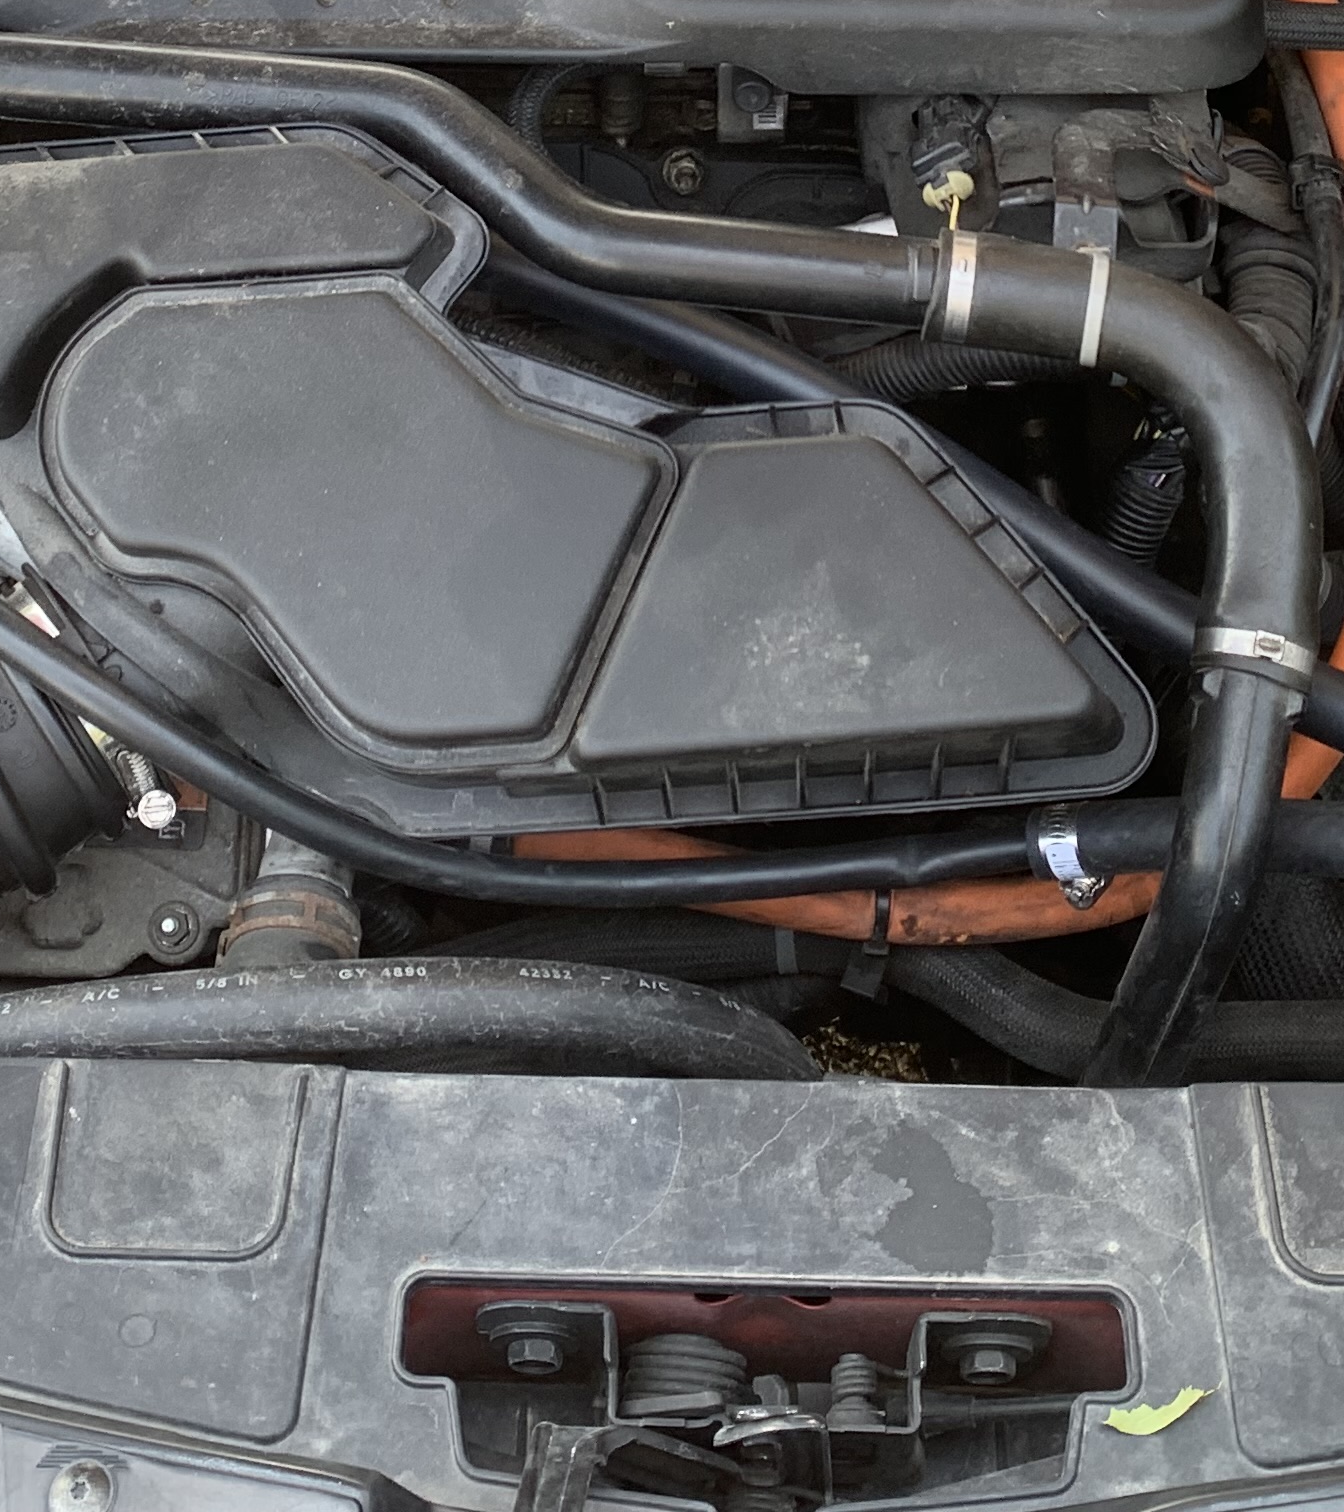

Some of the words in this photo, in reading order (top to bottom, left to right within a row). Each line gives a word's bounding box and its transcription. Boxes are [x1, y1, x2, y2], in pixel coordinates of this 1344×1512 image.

[81, 987, 120, 1004] A/C
[238, 974, 258, 987] IN
[380, 966, 427, 979] 4890
[639, 977, 670, 992] A/C
